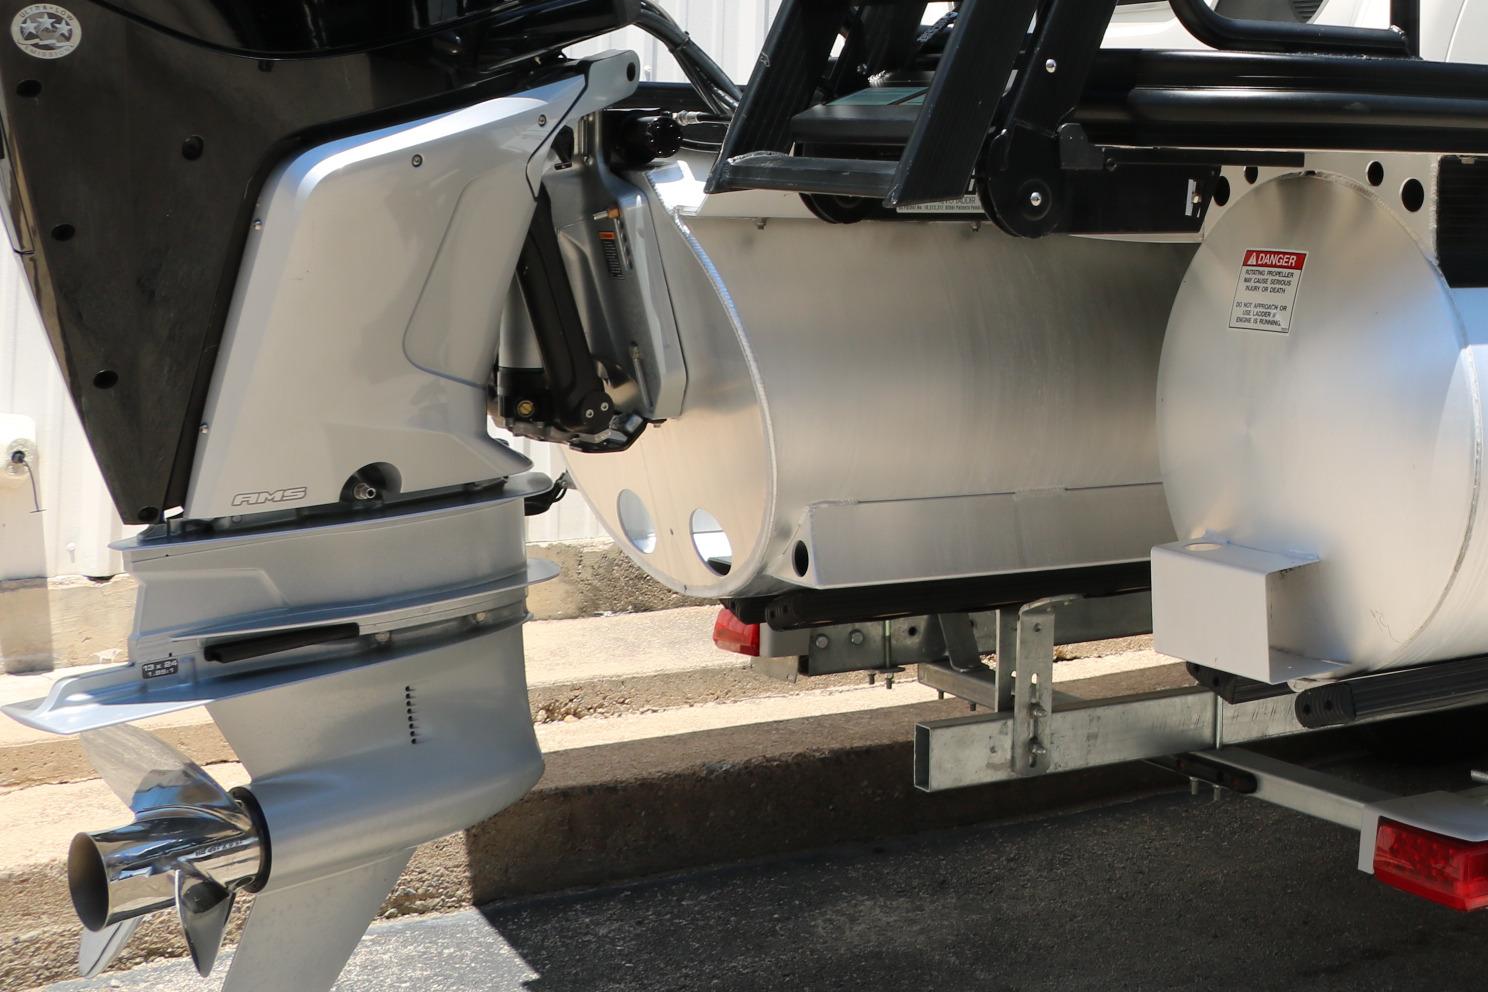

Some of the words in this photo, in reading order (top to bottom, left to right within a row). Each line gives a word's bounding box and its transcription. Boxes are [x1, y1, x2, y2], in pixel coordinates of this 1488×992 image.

[1257, 253, 1297, 267] DANGER
[1266, 270, 1295, 278] PROPELLER
[1252, 310, 1271, 318] LADDER
[231, 487, 307, 506] AMS
